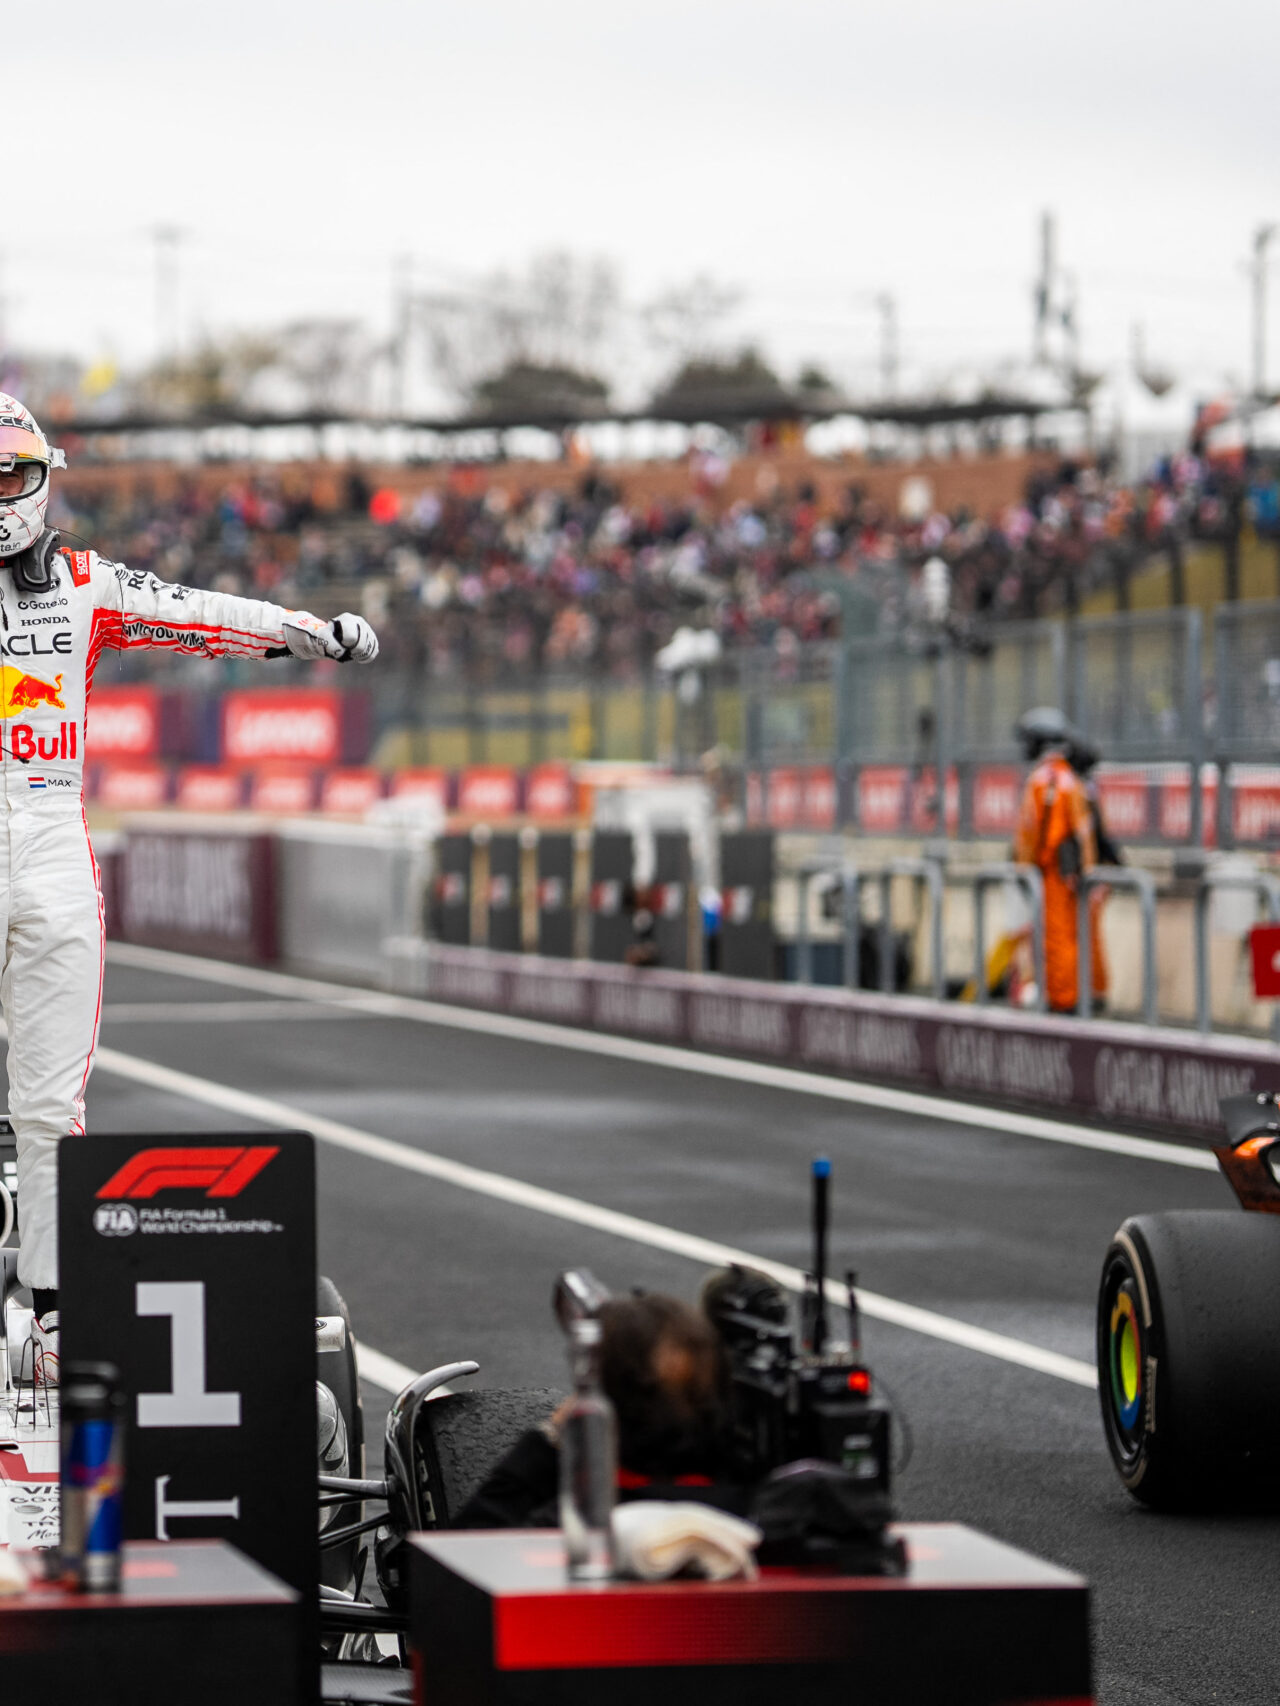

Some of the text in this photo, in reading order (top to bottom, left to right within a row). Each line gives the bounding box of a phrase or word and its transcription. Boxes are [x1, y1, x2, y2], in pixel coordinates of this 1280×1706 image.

[30, 598, 68, 610] Gate.io
[21, 616, 71, 626] HONDA
[12, 722, 77, 761] Bull
[48, 778, 72, 787] MAX
[139, 1208, 161, 1219] FIA
[164, 1208, 217, 1220] Formula
[140, 1221, 179, 1234] World
[136, 1281, 241, 1427] 1
